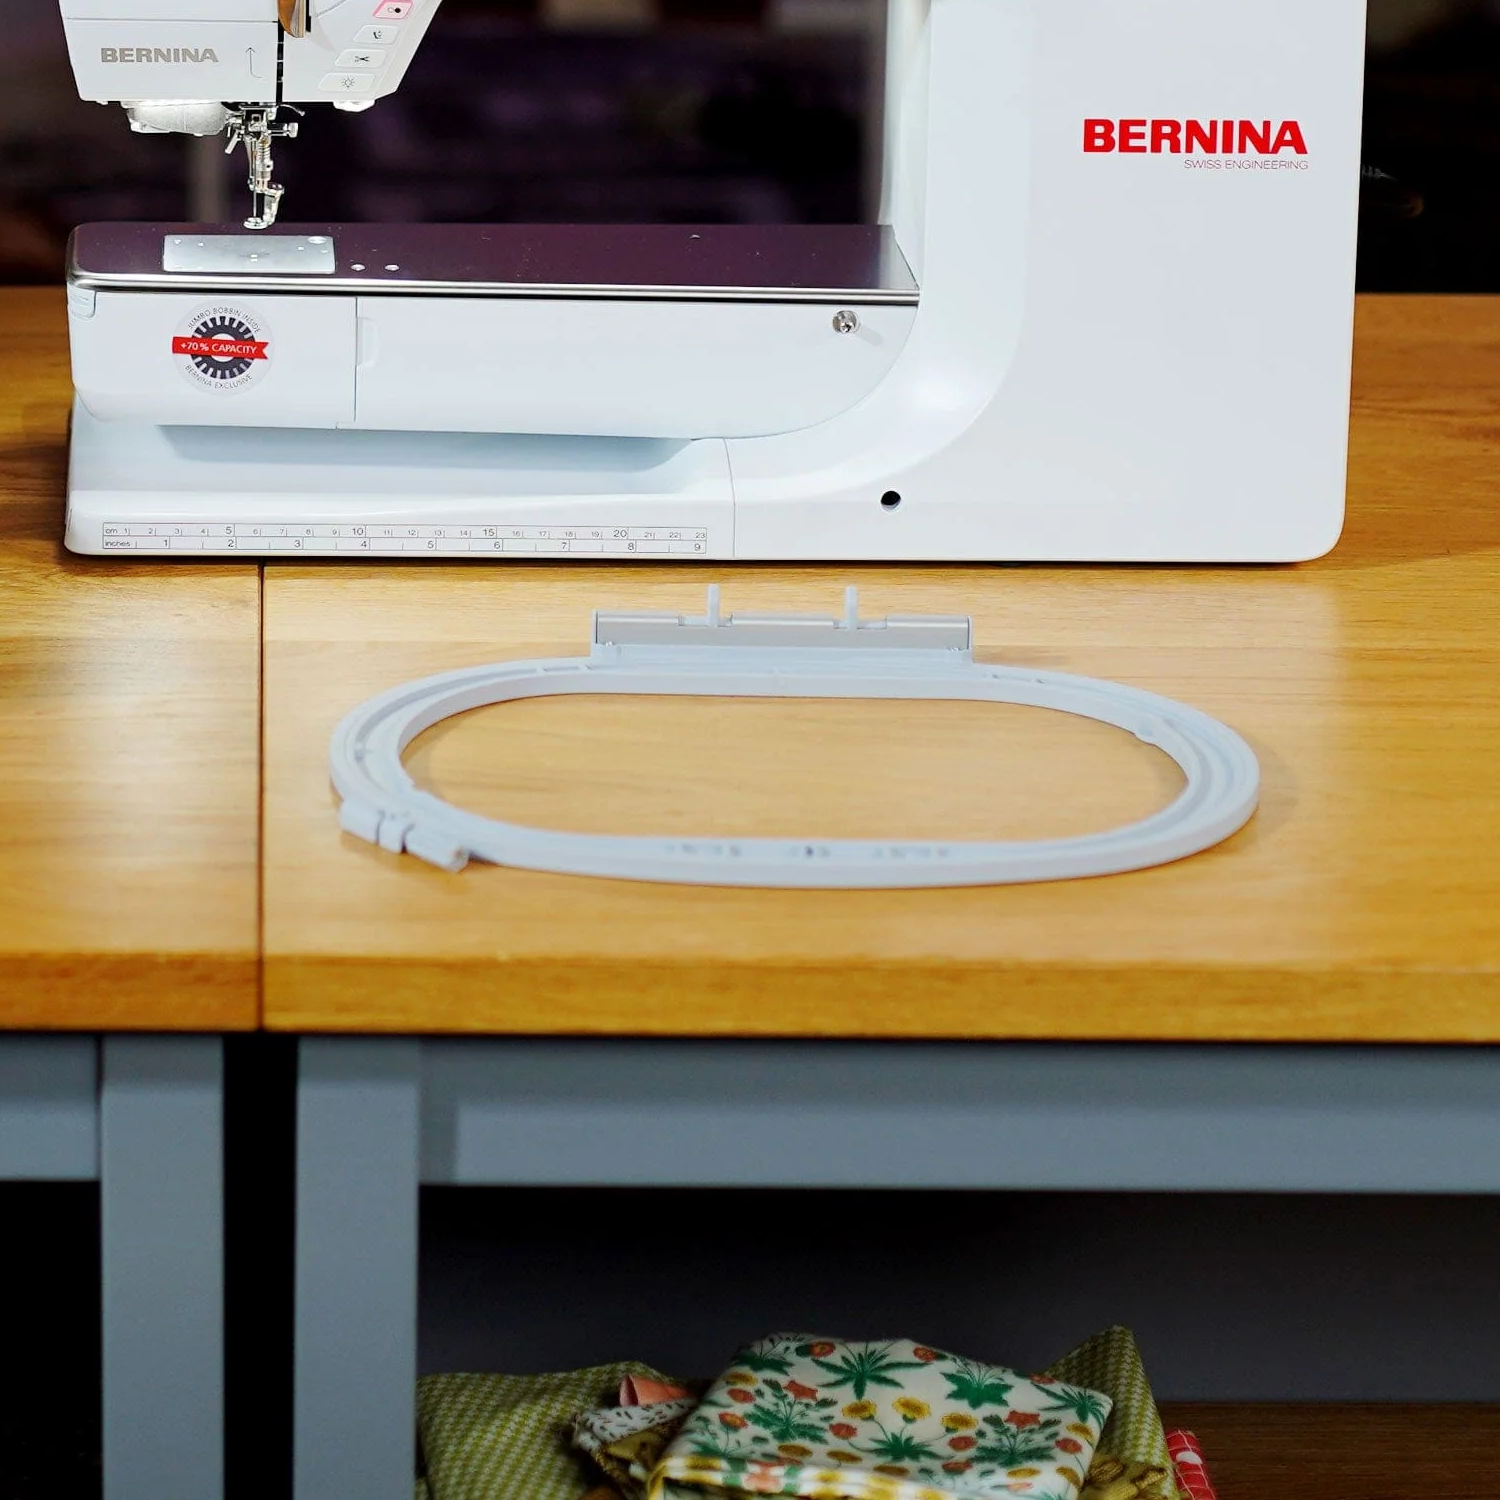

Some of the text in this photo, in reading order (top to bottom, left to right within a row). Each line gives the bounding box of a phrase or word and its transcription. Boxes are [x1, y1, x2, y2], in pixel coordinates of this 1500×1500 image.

[100, 48, 219, 63] BERNINA
[1083, 118, 1308, 154] BERNINA
[1183, 159, 1309, 170] SWISS ENGINEERING
[188, 309, 211, 329] JUMBO
[211, 343, 257, 354] CAPACITY
[225, 526, 232, 535] 5
[352, 527, 364, 535] 10
[483, 528, 495, 537] 15
[613, 529, 627, 538] 20
